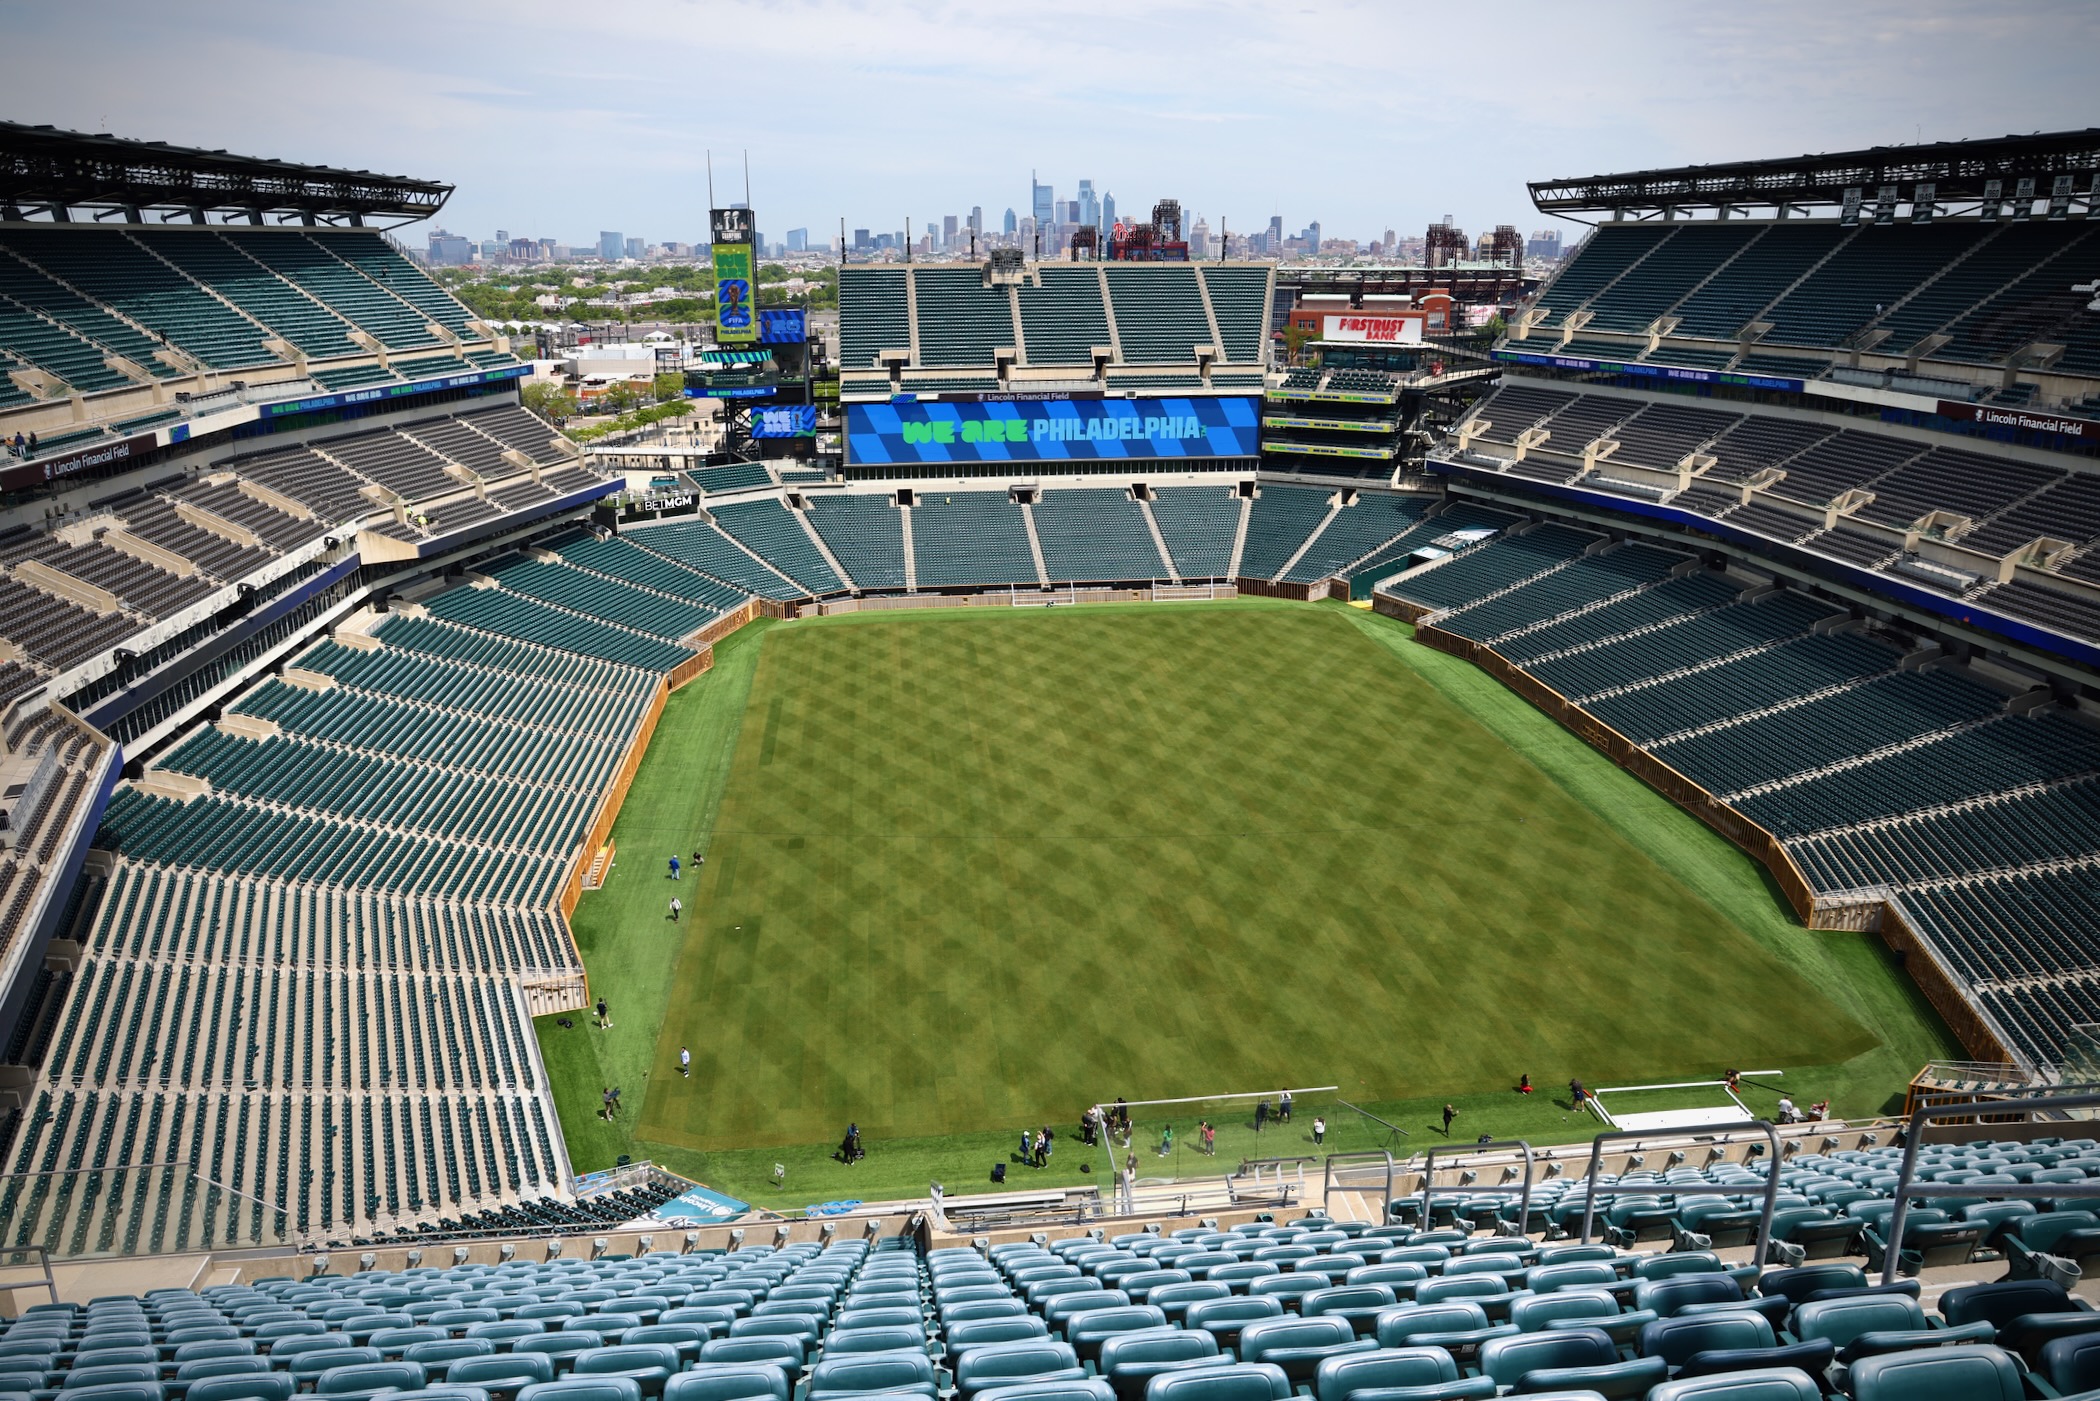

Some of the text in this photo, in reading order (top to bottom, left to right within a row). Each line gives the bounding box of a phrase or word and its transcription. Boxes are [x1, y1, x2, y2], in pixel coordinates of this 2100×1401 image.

[1339, 318, 1405, 332] FIRSTRUST
[1366, 332, 1397, 340] BANK
[1624, 365, 1657, 375] PHILADELPHIA
[413, 382, 442, 392] PHILADELPHIA
[1749, 377, 1790, 388] PHILADELPHIA
[300, 397, 336, 409] PHILADELPHIA
[763, 411, 791, 423] WE
[1986, 411, 2082, 435] Lincoln Financial Field
[764, 423, 791, 432] ARE
[903, 421, 955, 444] WE
[961, 419, 1028, 443] ARE
[1034, 416, 1200, 441] PHILADELPHIA
[54, 443, 130, 474] Lincoln Financial Field
[645, 495, 692, 511] BETMGM
[679, 1195, 713, 1212] Lincoln
[688, 1194, 720, 1208] Financial
